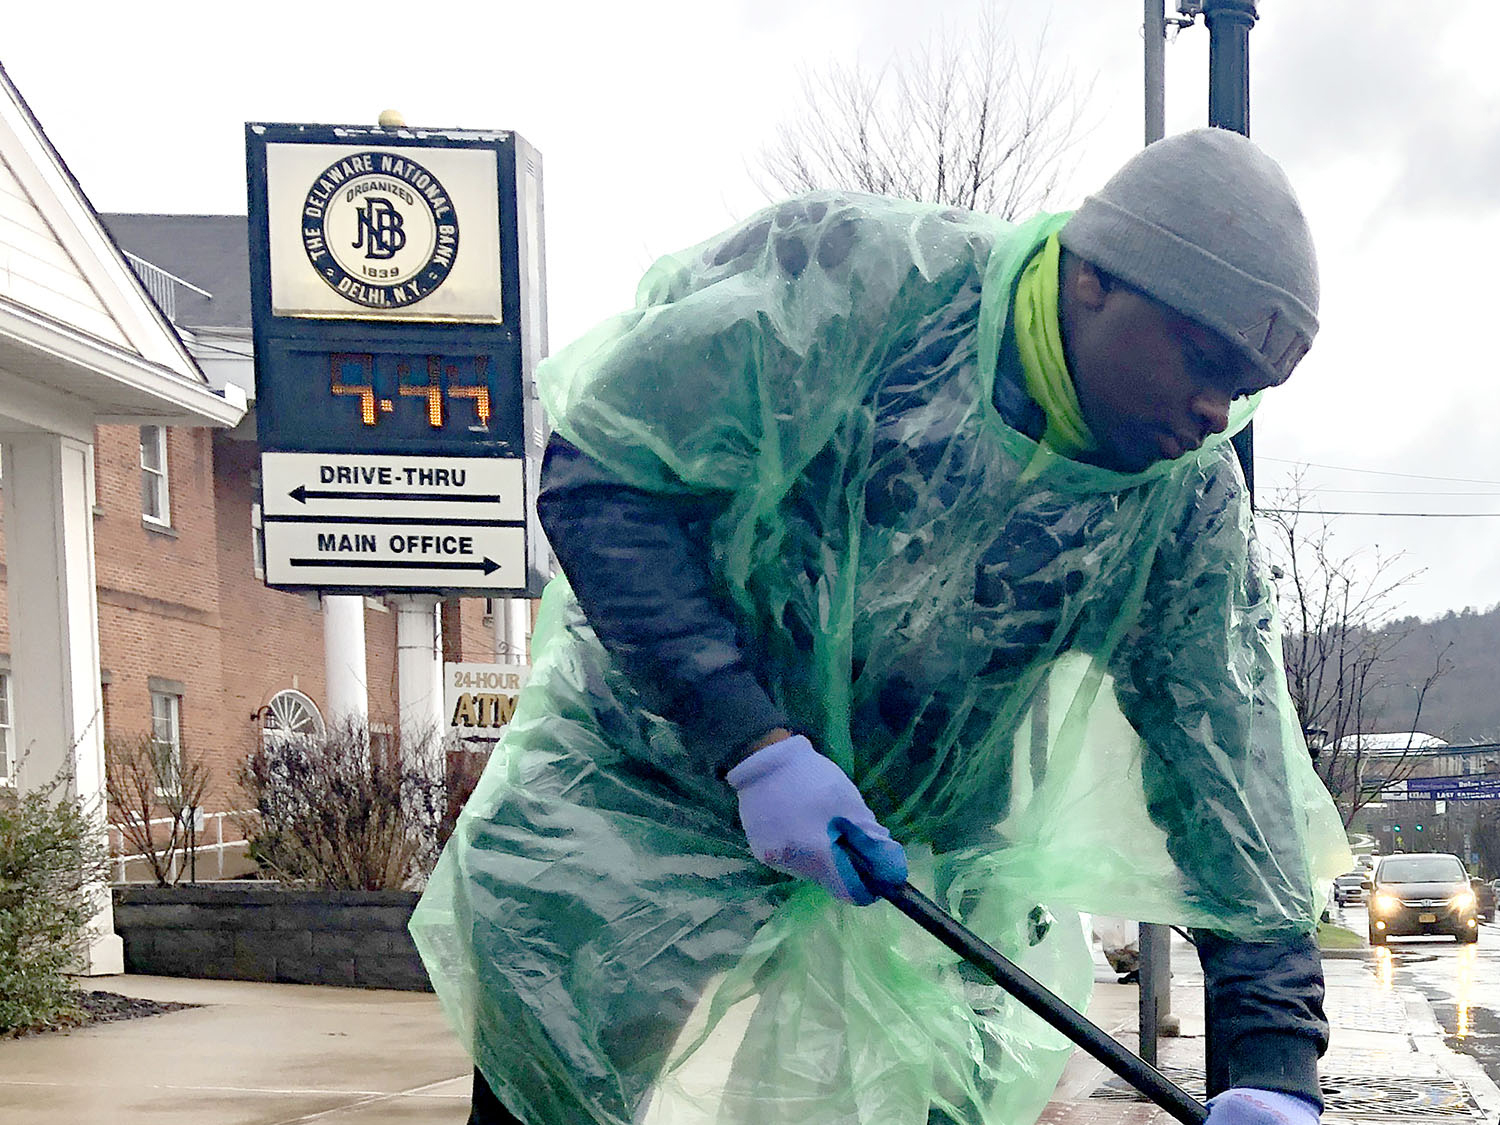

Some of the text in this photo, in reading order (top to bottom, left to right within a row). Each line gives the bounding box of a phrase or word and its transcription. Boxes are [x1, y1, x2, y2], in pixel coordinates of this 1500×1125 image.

[346, 181, 414, 206] ORGANIZED
[305, 155, 455, 268] THE DELAWARE NATIONAL BANK
[362, 265, 399, 278] 1839
[338, 277, 427, 305] DELHI, N.Y.
[320, 465, 466, 487] DRIVE-THRU
[317, 533, 473, 555] MAIN OFFICE
[454, 671, 520, 689] 24-HOUR
